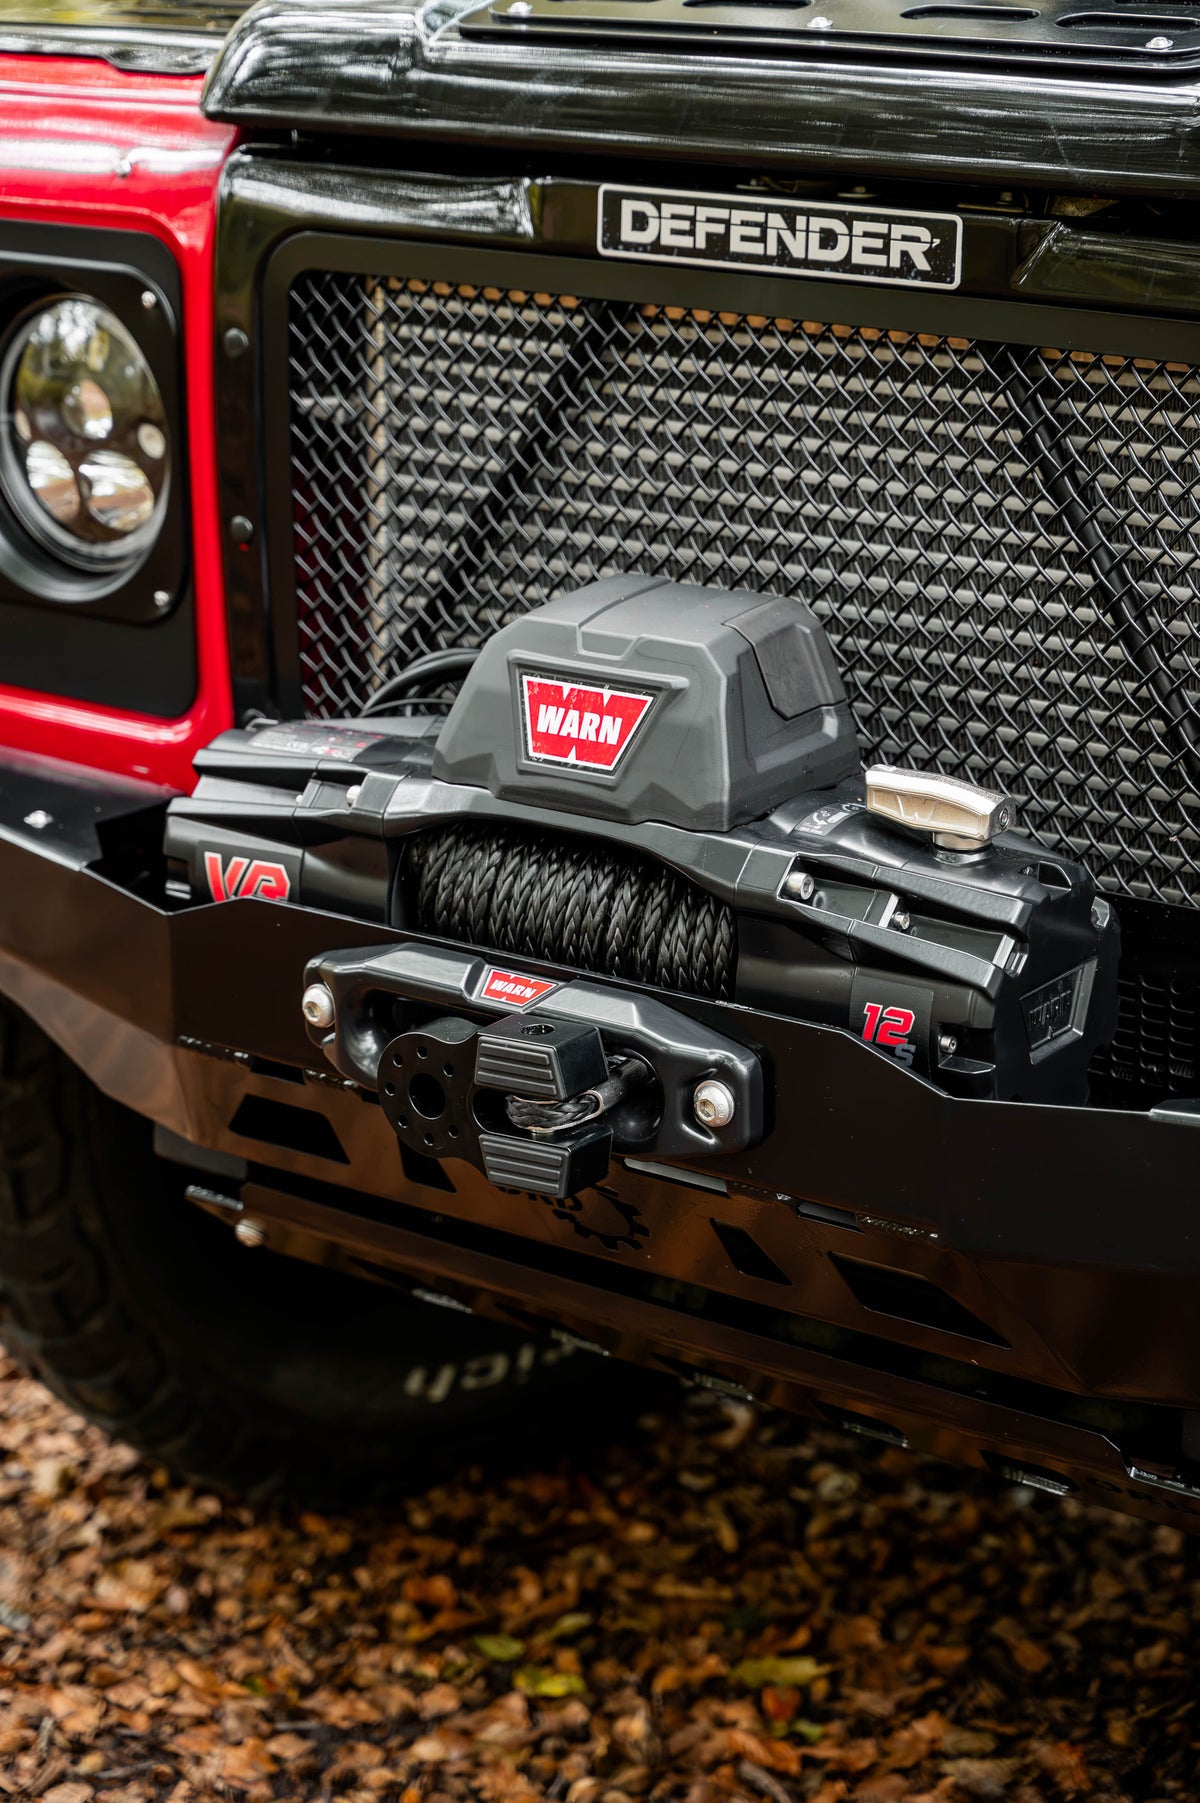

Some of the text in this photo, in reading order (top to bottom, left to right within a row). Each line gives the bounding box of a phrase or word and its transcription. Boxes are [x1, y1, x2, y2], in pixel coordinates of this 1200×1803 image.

[620, 199, 932, 271] DEFENDER
[536, 704, 623, 746] WARN
[490, 979, 538, 999] WARN
